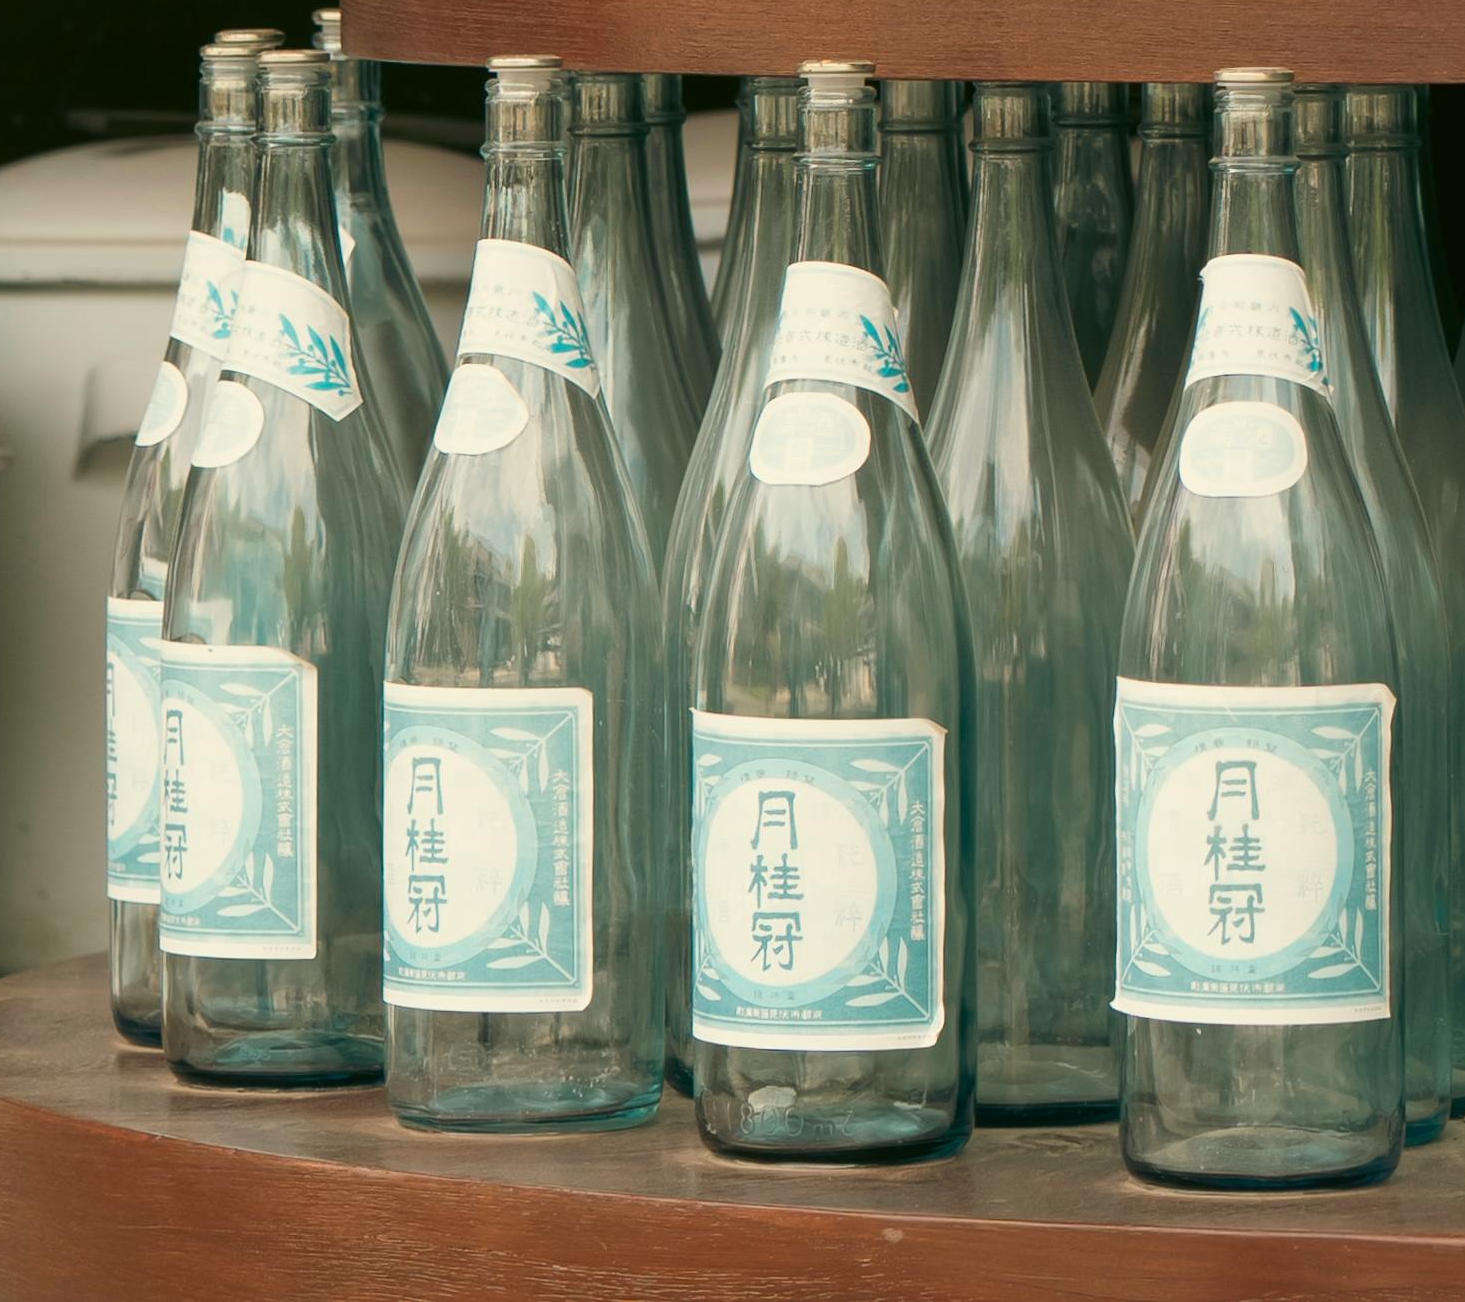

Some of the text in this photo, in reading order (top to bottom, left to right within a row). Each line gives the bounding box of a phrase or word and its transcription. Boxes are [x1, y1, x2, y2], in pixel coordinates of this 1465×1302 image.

[164, 709, 188, 880] 月桂冠
[405, 756, 449, 933] 月桂冠
[748, 790, 804, 972] 月桂冠
[1203, 760, 1266, 945] 月桂冠
